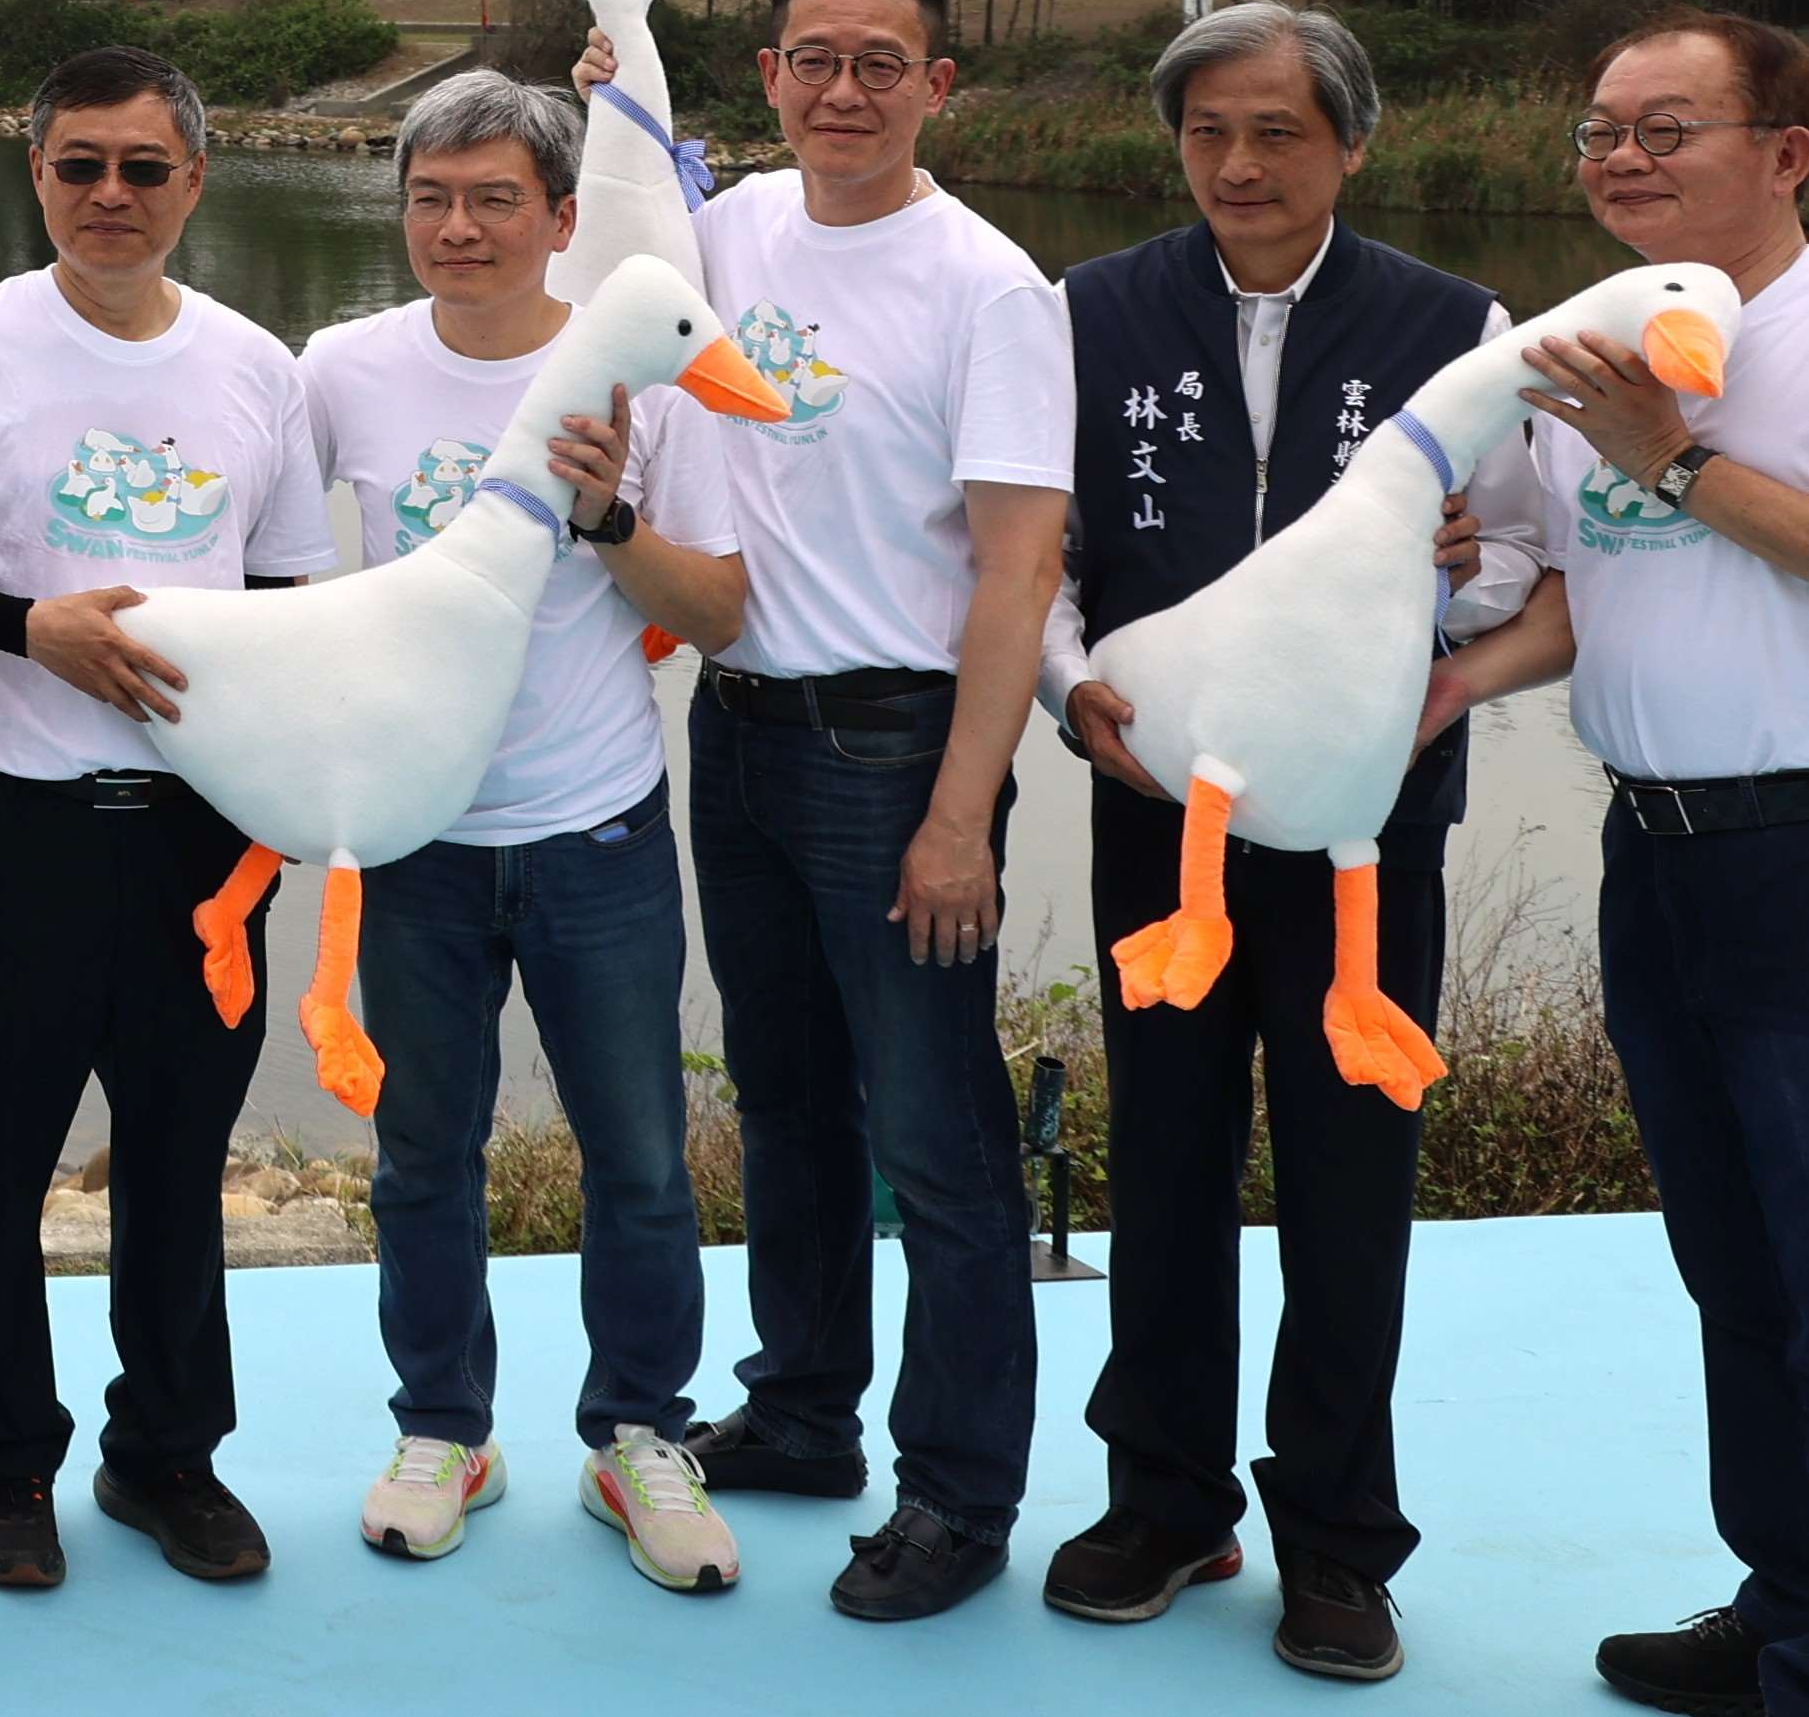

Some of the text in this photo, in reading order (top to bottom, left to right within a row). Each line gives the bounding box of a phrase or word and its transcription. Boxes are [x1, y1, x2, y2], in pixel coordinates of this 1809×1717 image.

[1174, 370, 1205, 442] 局長
[1331, 379, 1373, 483] 雲林縣
[1122, 385, 1169, 530] 林文山
[45, 518, 124, 559] SWAN
